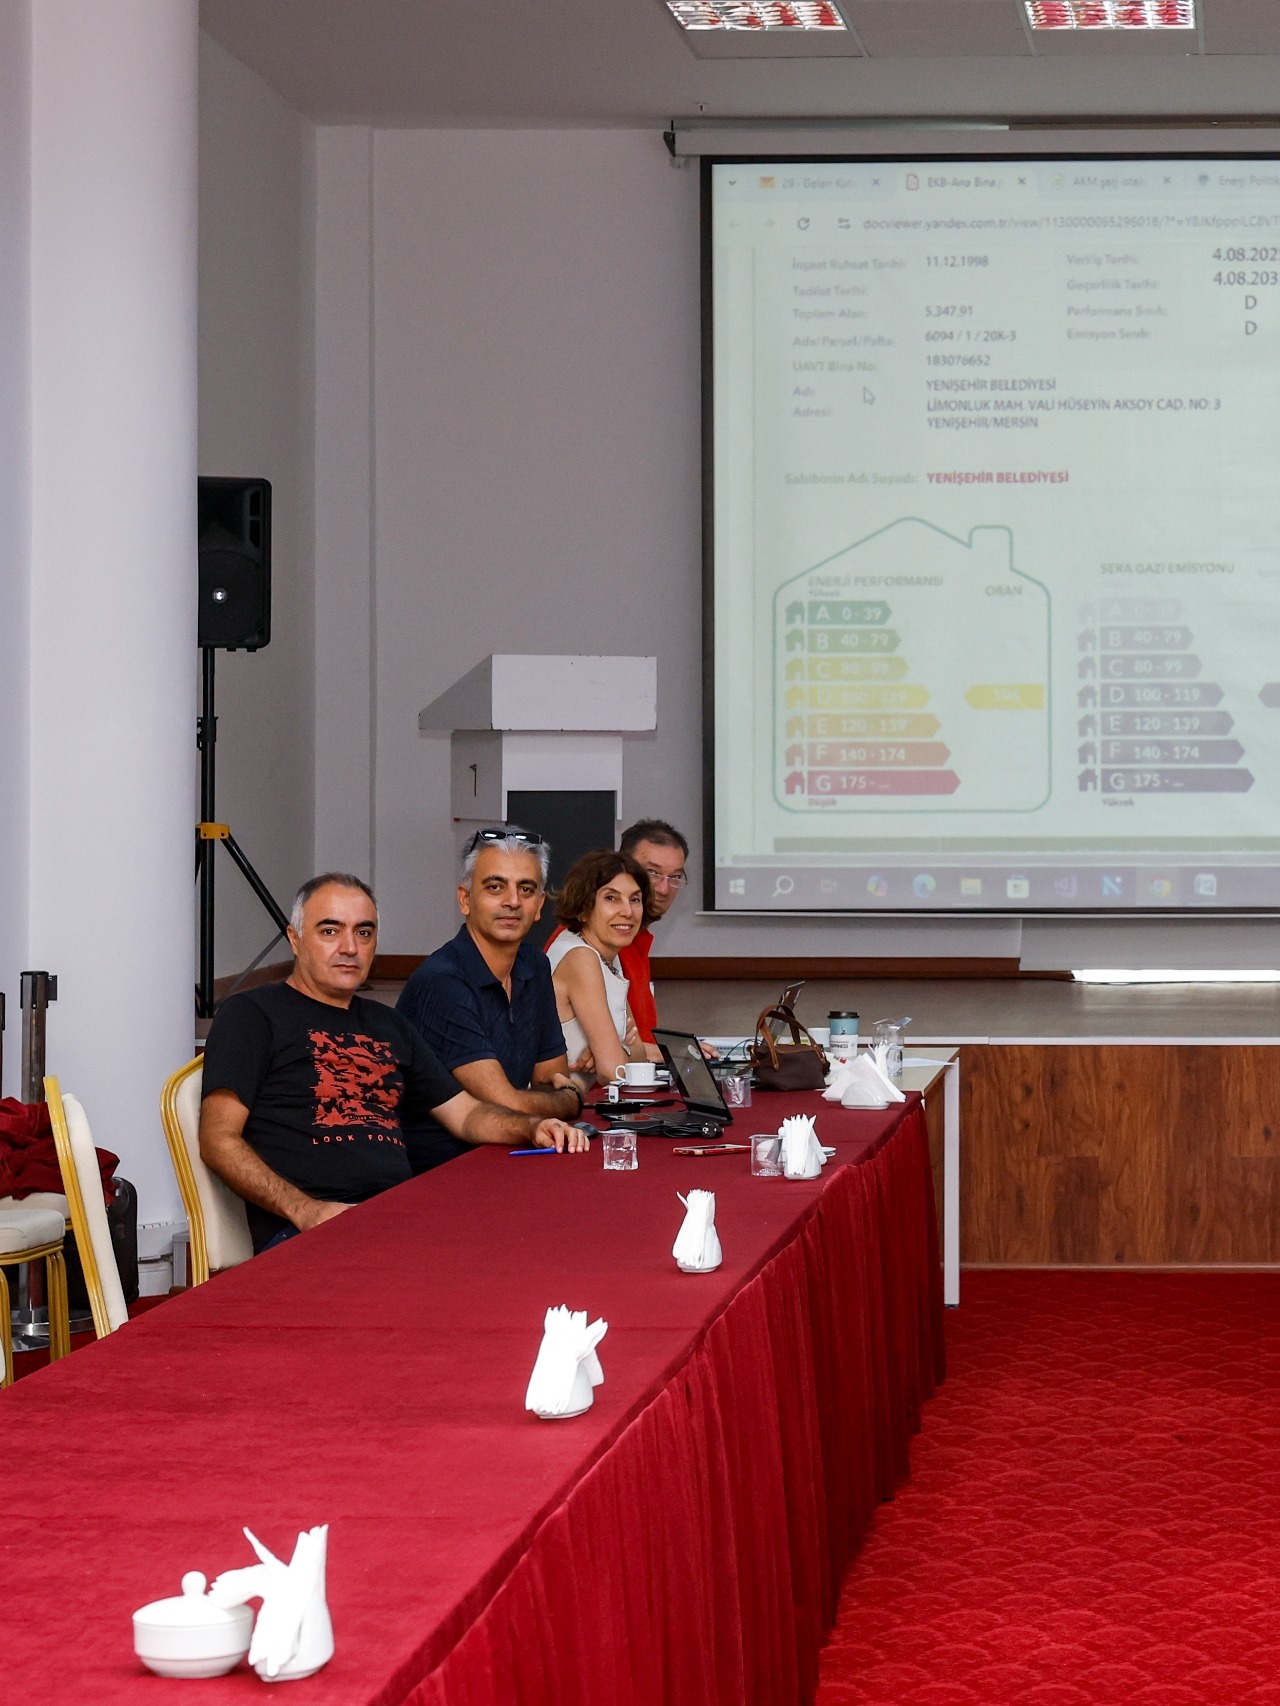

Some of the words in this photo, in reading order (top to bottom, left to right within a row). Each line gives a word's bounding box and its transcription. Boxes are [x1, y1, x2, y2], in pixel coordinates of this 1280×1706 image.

[926, 255, 989, 268] 11.12.1998
[1067, 304, 1132, 317] Performans
[1244, 294, 1257, 311] D
[793, 307, 835, 320] Toplam
[924, 330, 954, 342] 6094
[1067, 328, 1116, 341] Emisyon
[1244, 320, 1257, 336] D
[792, 361, 824, 372] UAVT
[828, 361, 853, 372] Bina
[926, 354, 991, 367] 183076652
[926, 378, 988, 394] YENİŞEHİR
[990, 377, 1056, 392] BELEDİYESİ
[792, 406, 834, 418] Adresi:
[926, 397, 991, 412] LİMONLUK
[1114, 397, 1155, 411] AKSOY
[1157, 397, 1187, 411] CAD.
[1213, 397, 1222, 411] 3
[926, 469, 994, 486] YENİŞEHİR
[996, 468, 1070, 485] BELEDİYESİ
[1101, 562, 1133, 574] SERA
[1168, 560, 1236, 574] EMİSYONU
[808, 575, 851, 588] ENERJİ
[854, 575, 944, 587] PERFORMANSI
[985, 584, 1023, 597] ORAN
[816, 605, 831, 621] A
[841, 607, 852, 620] 0
[863, 607, 882, 620] 39
[816, 633, 829, 650] B
[841, 634, 859, 646] 40
[870, 634, 889, 646] 79
[1109, 631, 1122, 647] B
[1134, 631, 1151, 643] 40
[1164, 631, 1182, 644] 79
[816, 662, 831, 679] C
[1109, 658, 1124, 676] C
[1134, 660, 1152, 673] 80
[1164, 660, 1183, 673] 99
[1109, 686, 1125, 702] D
[1134, 688, 1160, 700] 100
[1174, 688, 1200, 700] 119
[817, 717, 828, 734] E
[1110, 715, 1121, 731] E
[1134, 717, 1160, 730] 120
[1174, 717, 1200, 730] 139
[816, 744, 828, 761] F
[841, 747, 866, 761] 140
[880, 747, 906, 761] 174
[1110, 742, 1121, 759] F
[1134, 746, 1160, 760] 140
[1174, 746, 1200, 760] 174
[816, 774, 832, 792] G
[841, 775, 866, 789] 175
[1110, 773, 1126, 790] G
[1134, 774, 1160, 788] 175
[312, 1134, 355, 1145] LOOK
